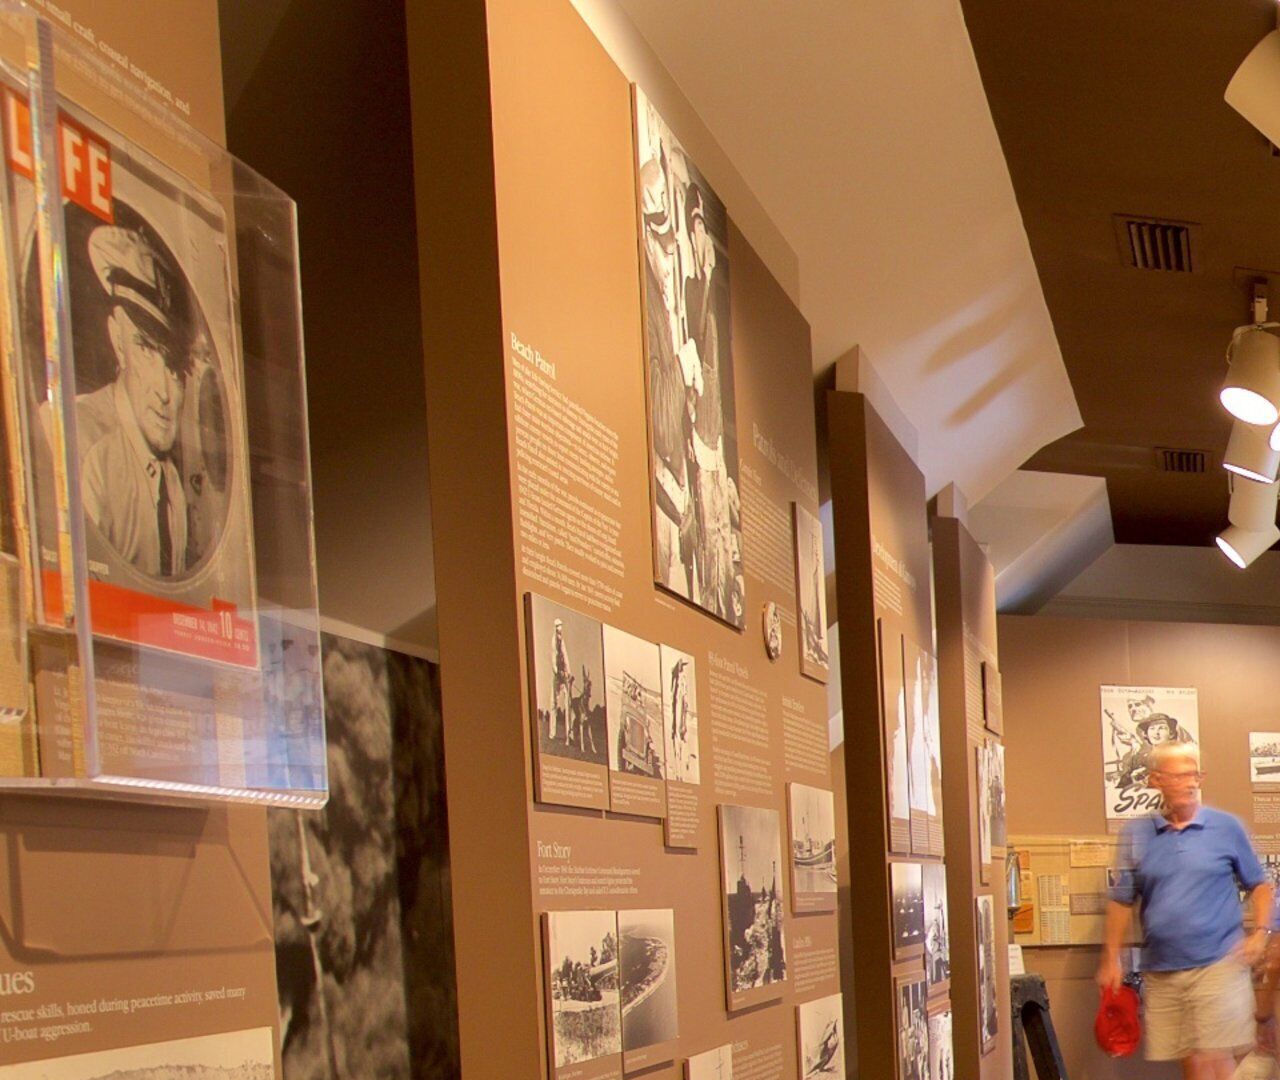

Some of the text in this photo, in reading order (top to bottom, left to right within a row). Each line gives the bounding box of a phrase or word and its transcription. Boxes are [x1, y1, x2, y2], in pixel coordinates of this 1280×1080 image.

[9, 95, 111, 215] LFE
[511, 331, 556, 380] Beach Patrol
[219, 611, 234, 640] 10
[537, 840, 571, 864] Fort Story
[0, 1007, 35, 1024] rescue
[37, 1003, 65, 1020] skills,
[67, 999, 97, 1016] honed
[99, 998, 130, 1015] during
[131, 992, 173, 1012] peacetime
[205, 986, 225, 1001] saved
[3, 1020, 93, 1042] U-boat aggression.
